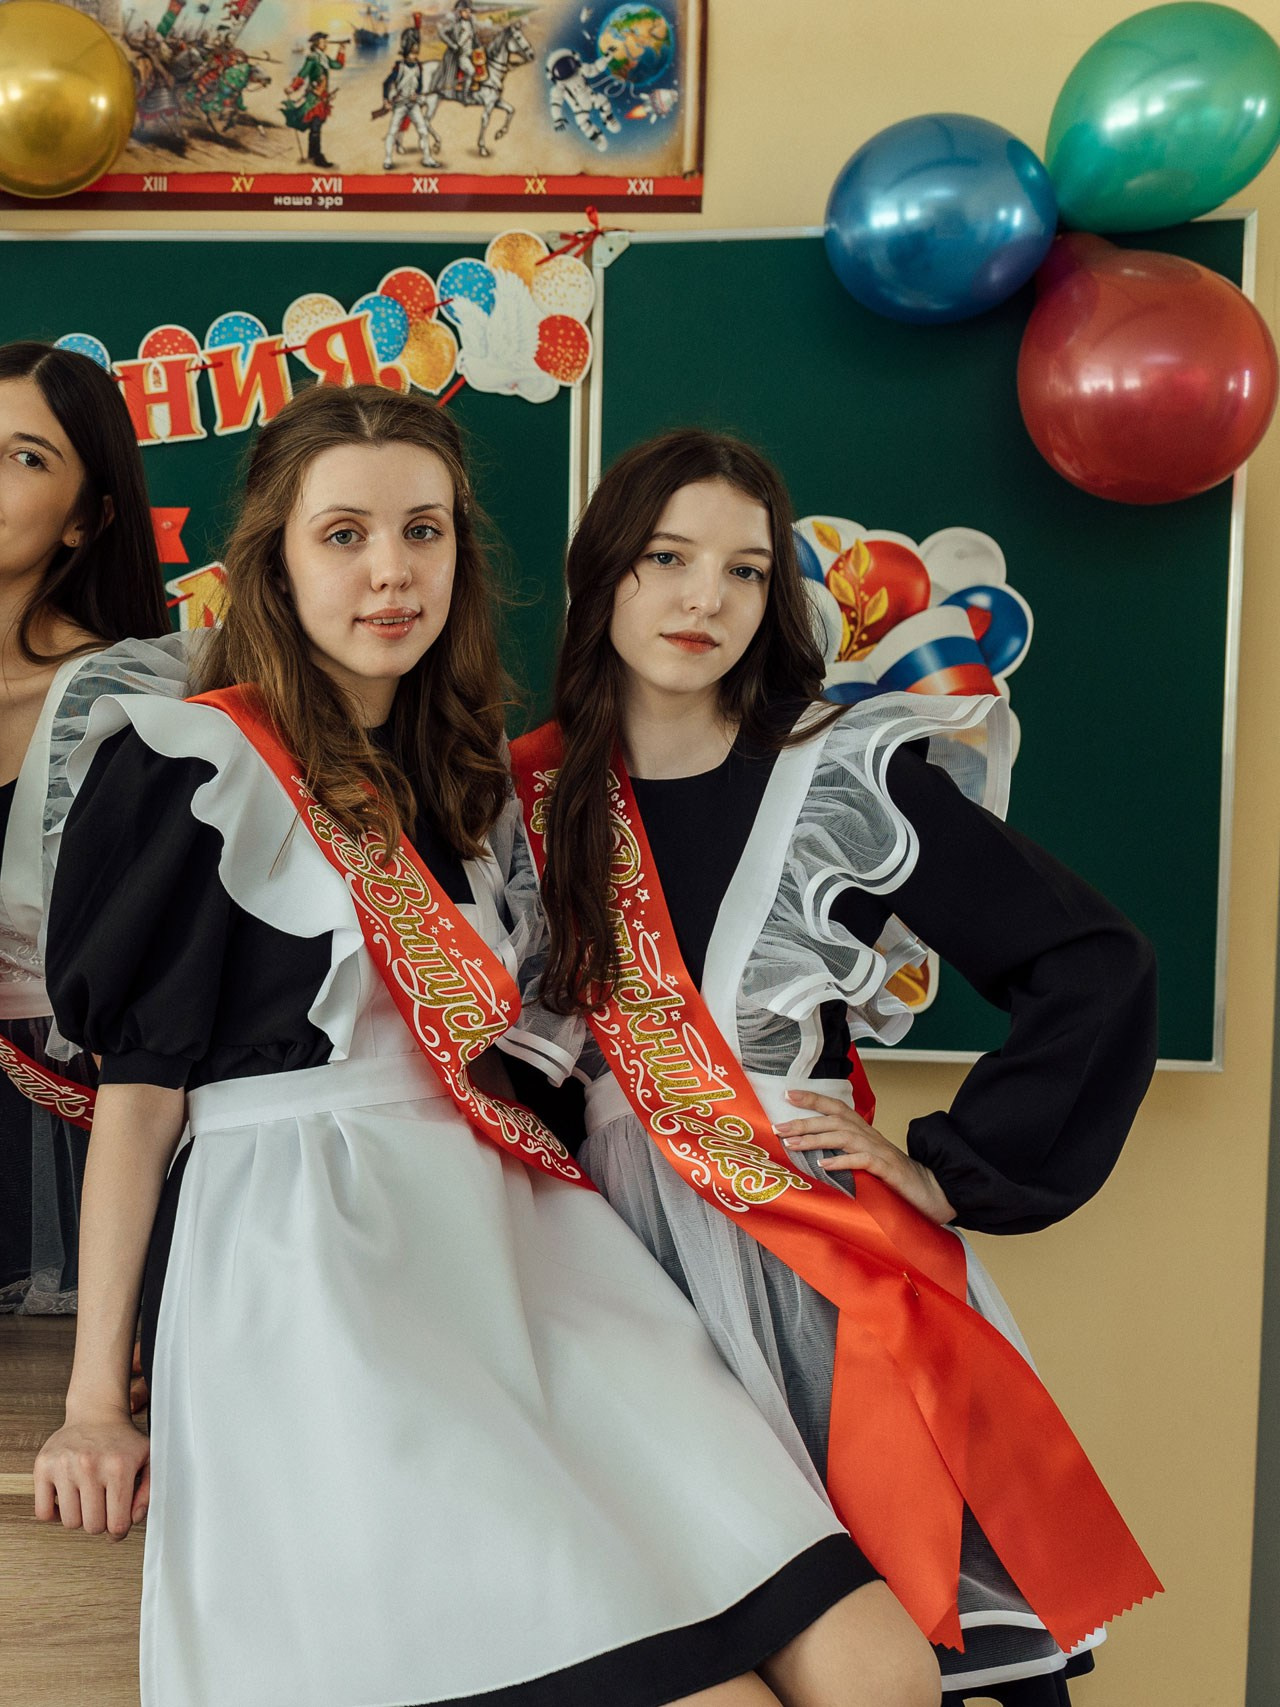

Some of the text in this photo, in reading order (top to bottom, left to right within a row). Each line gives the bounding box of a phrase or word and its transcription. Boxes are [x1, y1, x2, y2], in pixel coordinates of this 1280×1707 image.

[142, 176, 168, 192] XIII
[231, 176, 255, 192] XV
[311, 177, 342, 193] XVII
[412, 177, 439, 193] XIX
[524, 178, 547, 195] XX
[627, 178, 654, 195] XXI
[274, 196, 343, 209] наша эра
